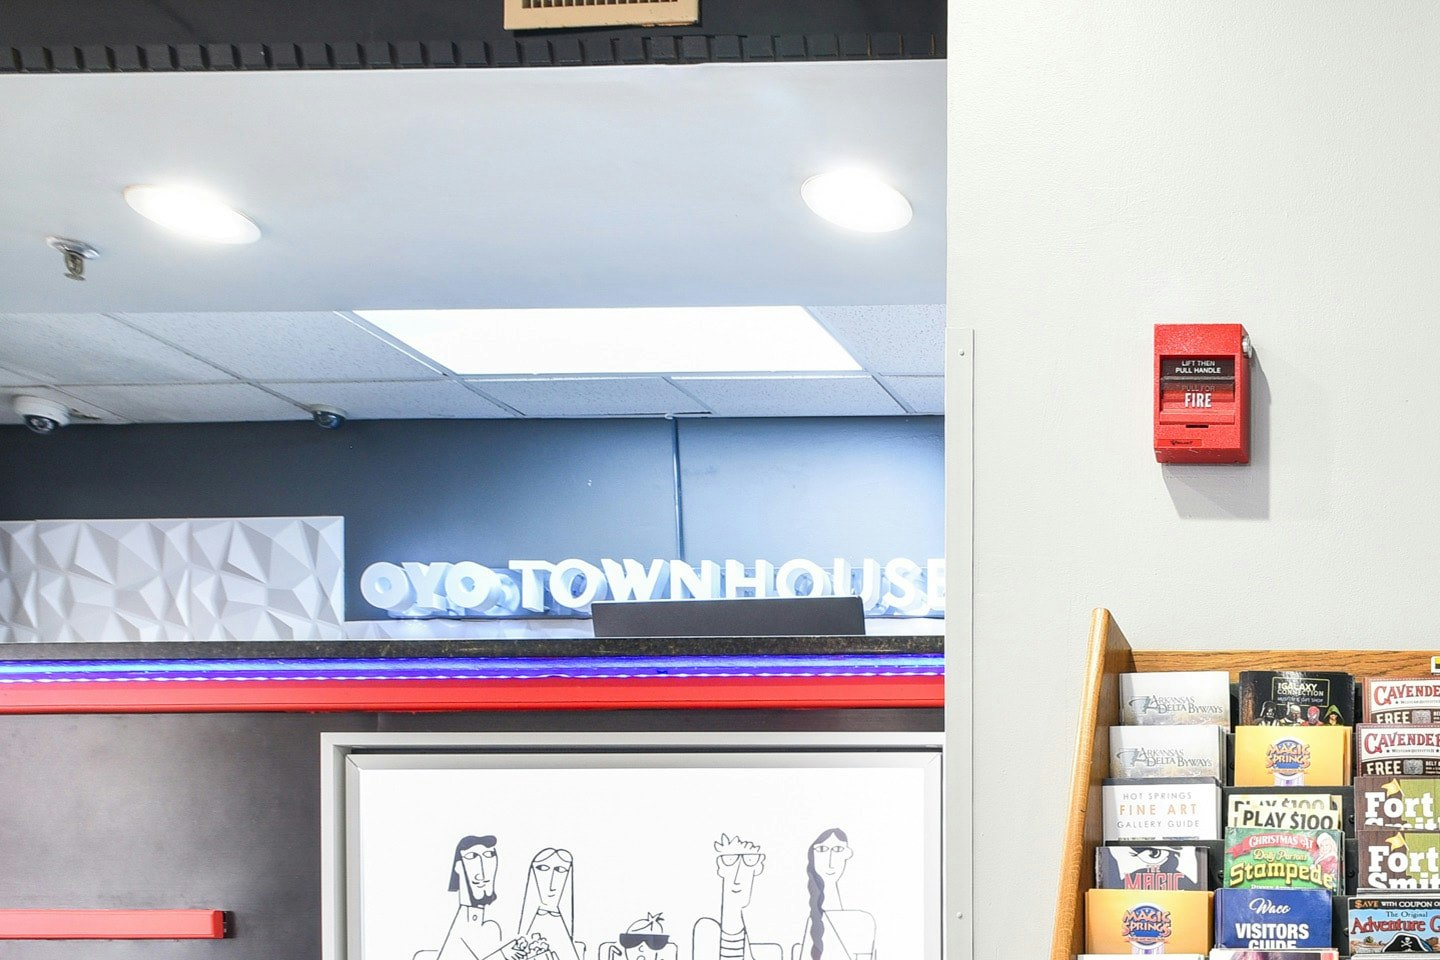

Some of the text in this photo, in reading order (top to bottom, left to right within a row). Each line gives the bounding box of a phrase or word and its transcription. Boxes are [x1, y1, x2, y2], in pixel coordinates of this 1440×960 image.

[1184, 393, 1212, 408] FIRE
[360, 560, 492, 612] OYO
[1376, 711, 1411, 723] FREE
[1366, 760, 1402, 775] FREE
[1123, 791, 1192, 801] HOT SPRINGS
[1119, 803, 1197, 816] FINE ART
[1364, 791, 1434, 818] Fort
[1116, 819, 1200, 829] GALLERY GUIDE
[1243, 809, 1333, 830] PLAY $100
[1368, 845, 1440, 873] Fort
[1230, 862, 1334, 890] Stampede
[1249, 898, 1291, 915] Waco
[1398, 900, 1432, 908] COUPON
[1385, 910, 1429, 919] The Original
[1235, 922, 1310, 940] VISITORS
[1350, 916, 1426, 935] Adventure
